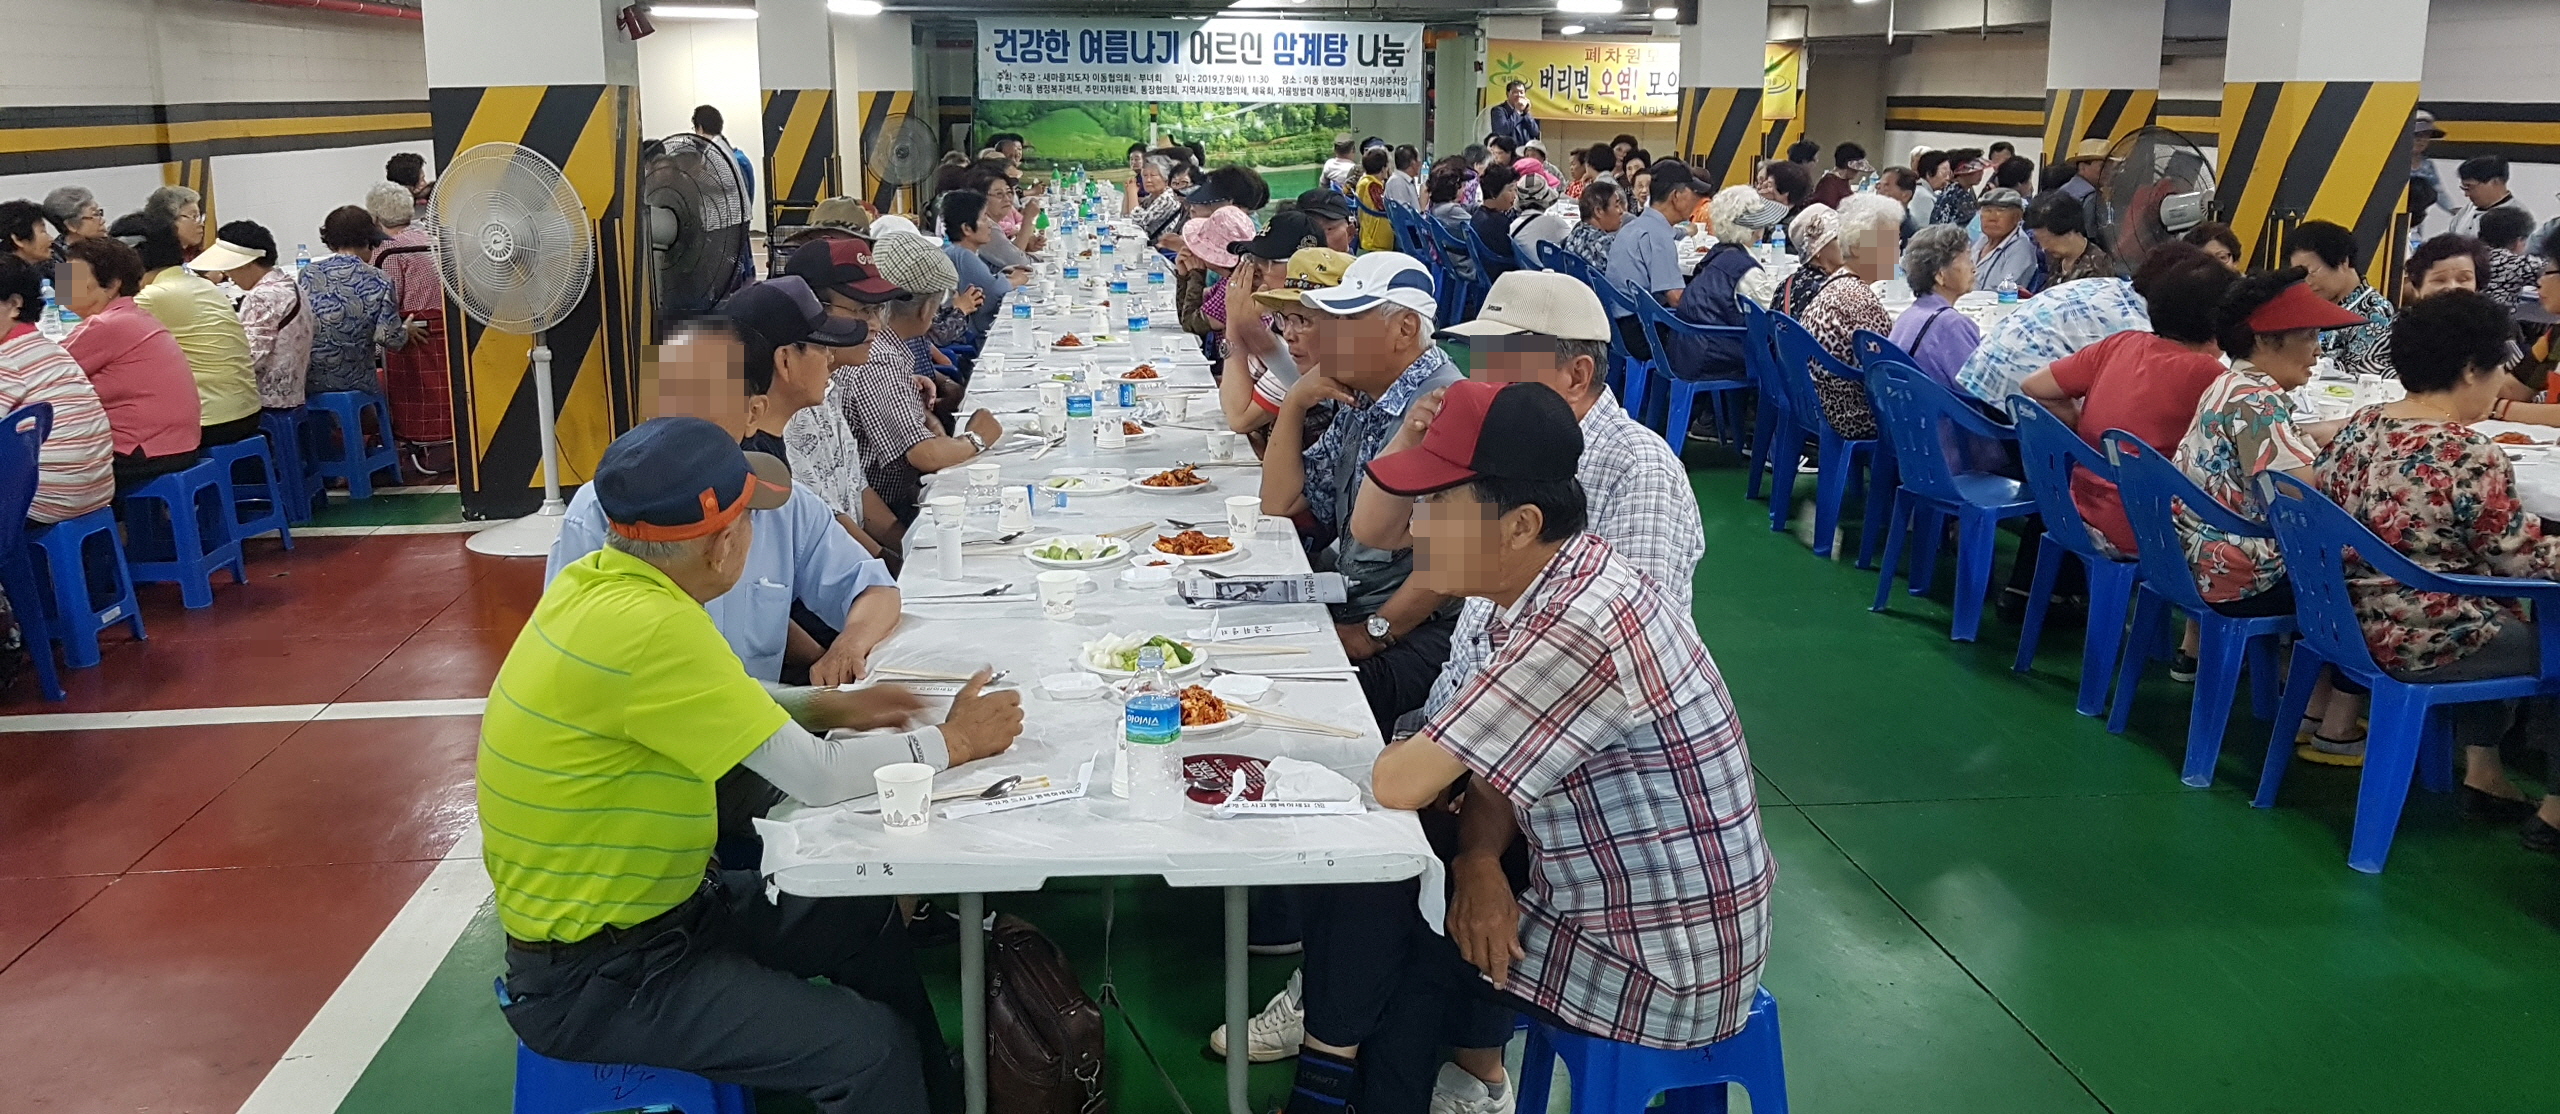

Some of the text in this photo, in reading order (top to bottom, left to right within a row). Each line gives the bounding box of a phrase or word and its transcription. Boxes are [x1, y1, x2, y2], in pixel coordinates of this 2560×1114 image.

[994, 28, 1406, 67] 건강한 여름나기 어르신 삼계탕 나눔
[1020, 73, 1036, 82] 주관
[1043, 72, 1090, 83] 새마을지도자
[1092, 73, 1132, 84] 이동협의회
[1139, 73, 1162, 83] 부녀회
[1175, 73, 1190, 84] 일시
[1282, 75, 1297, 85] 장소
[1303, 75, 1319, 86] 이동
[1322, 75, 1368, 86] 행정복지센터
[1370, 76, 1408, 86] 지하주차장
[1540, 64, 1589, 100] 버리면
[1598, 67, 1637, 101] 오염!
[997, 83, 1012, 93] 후원
[1018, 83, 1034, 94] 이동
[1573, 103, 1595, 115] 이동
[1600, 104, 1610, 115] 남
[1622, 104, 1632, 116] 여
[1126, 713, 1160, 727] 아이시스
